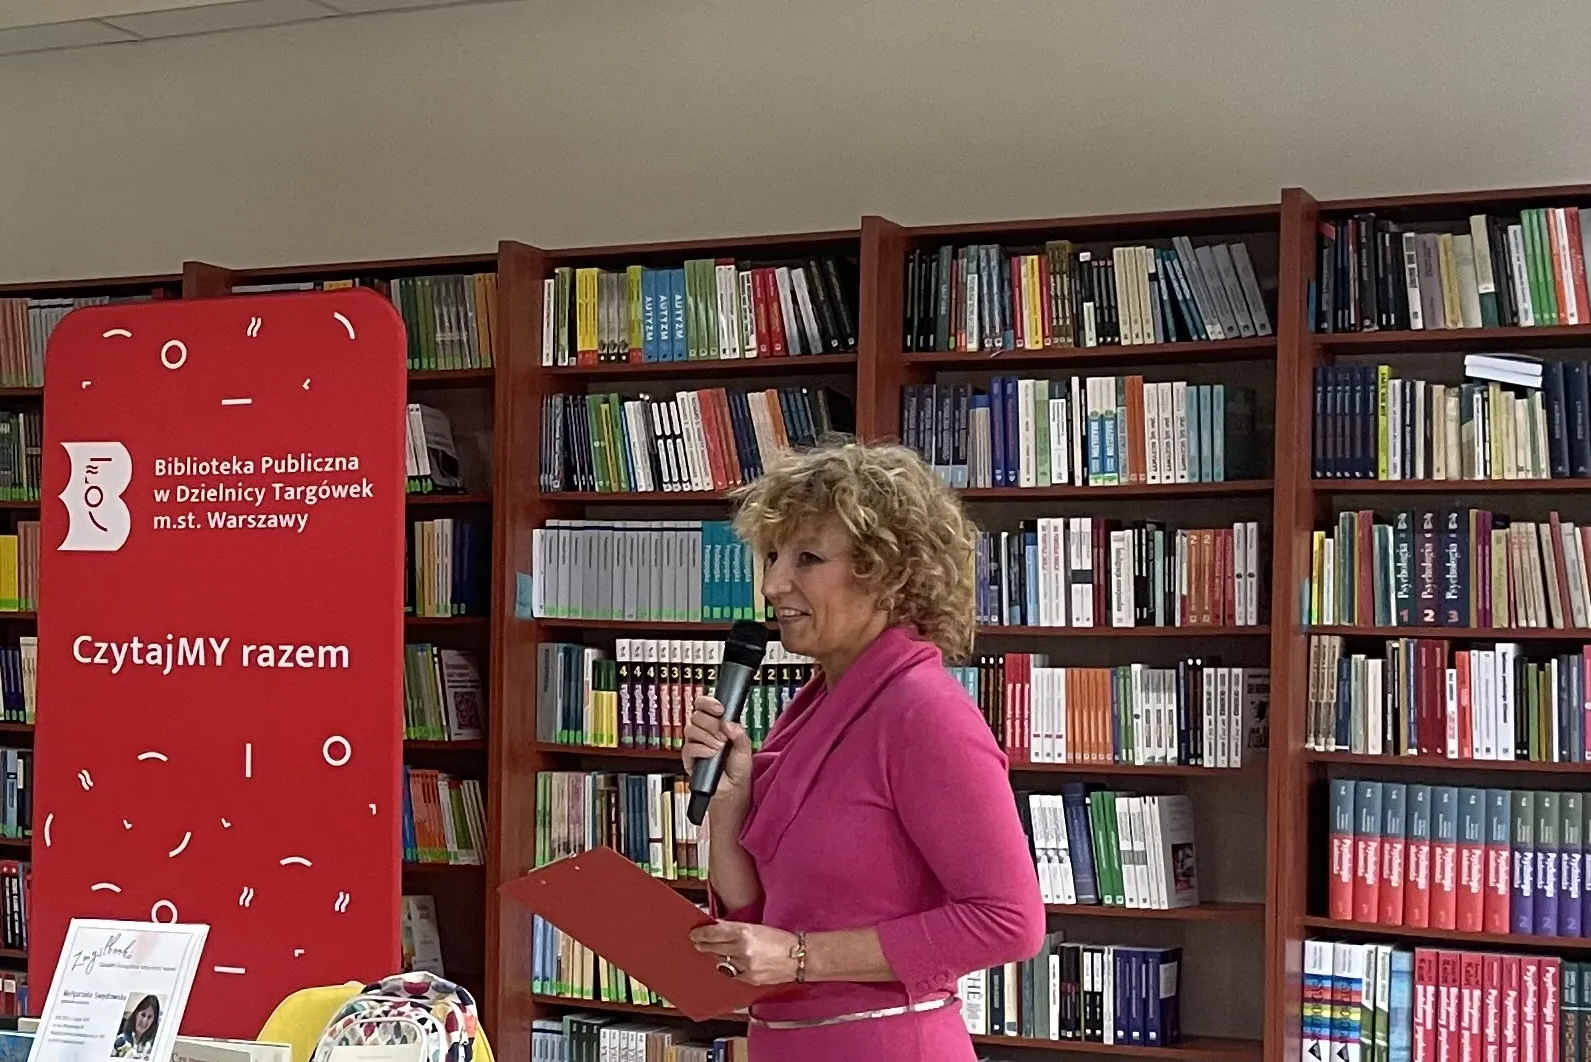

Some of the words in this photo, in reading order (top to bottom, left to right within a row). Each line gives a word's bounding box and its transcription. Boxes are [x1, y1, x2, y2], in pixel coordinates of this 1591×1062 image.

[645, 296, 654, 341] AUTYZM
[659, 296, 668, 340] AUTYZM
[674, 294, 683, 339] AUTYZM
[155, 457, 254, 476] Biblioteka
[261, 454, 359, 474] Publiczna
[154, 486, 171, 502] w
[176, 483, 265, 506] Dzielnicy
[272, 478, 373, 503] Targówek
[153, 511, 201, 530] m.st.
[208, 511, 308, 534] Warszawy
[1190, 535, 1197, 544] 2
[1204, 535, 1211, 544] 2
[1396, 543, 1412, 599] Psychologia
[1421, 543, 1437, 598] Psychologia
[1445, 544, 1461, 599] Psychologia
[72, 634, 230, 675] CzytajMY
[242, 641, 350, 669] razem
[620, 666, 627, 677] 4
[634, 666, 642, 677] 4
[647, 667, 654, 677] 4
[661, 667, 668, 677] 3
[671, 667, 678, 678] 3
[684, 667, 691, 678] 3
[695, 668, 702, 679] 3
[708, 669, 716, 680] 2
[768, 669, 775, 680] 2
[782, 669, 789, 680] 1
[795, 669, 802, 680] 1
[1523, 965, 1536, 1020] Psychologia
[1543, 966, 1556, 1022] Psychologia
